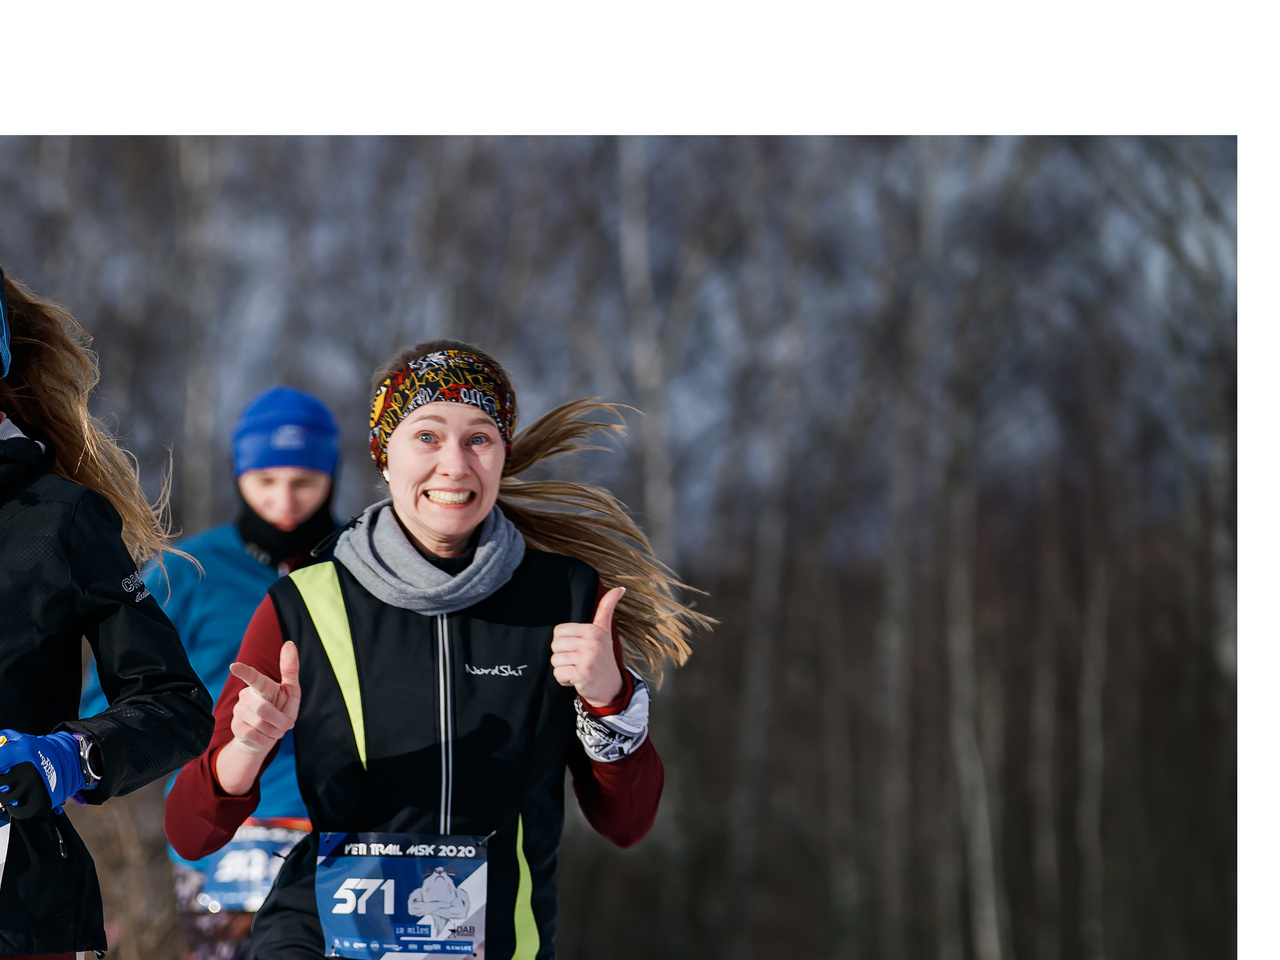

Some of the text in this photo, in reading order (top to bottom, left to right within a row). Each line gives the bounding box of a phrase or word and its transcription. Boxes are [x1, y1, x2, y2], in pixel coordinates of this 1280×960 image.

[370, 843, 403, 855] TRAIL
[406, 844, 435, 856] MSK
[437, 845, 476, 857] 2020
[331, 878, 395, 915] 571
[457, 925, 475, 934] DAB
